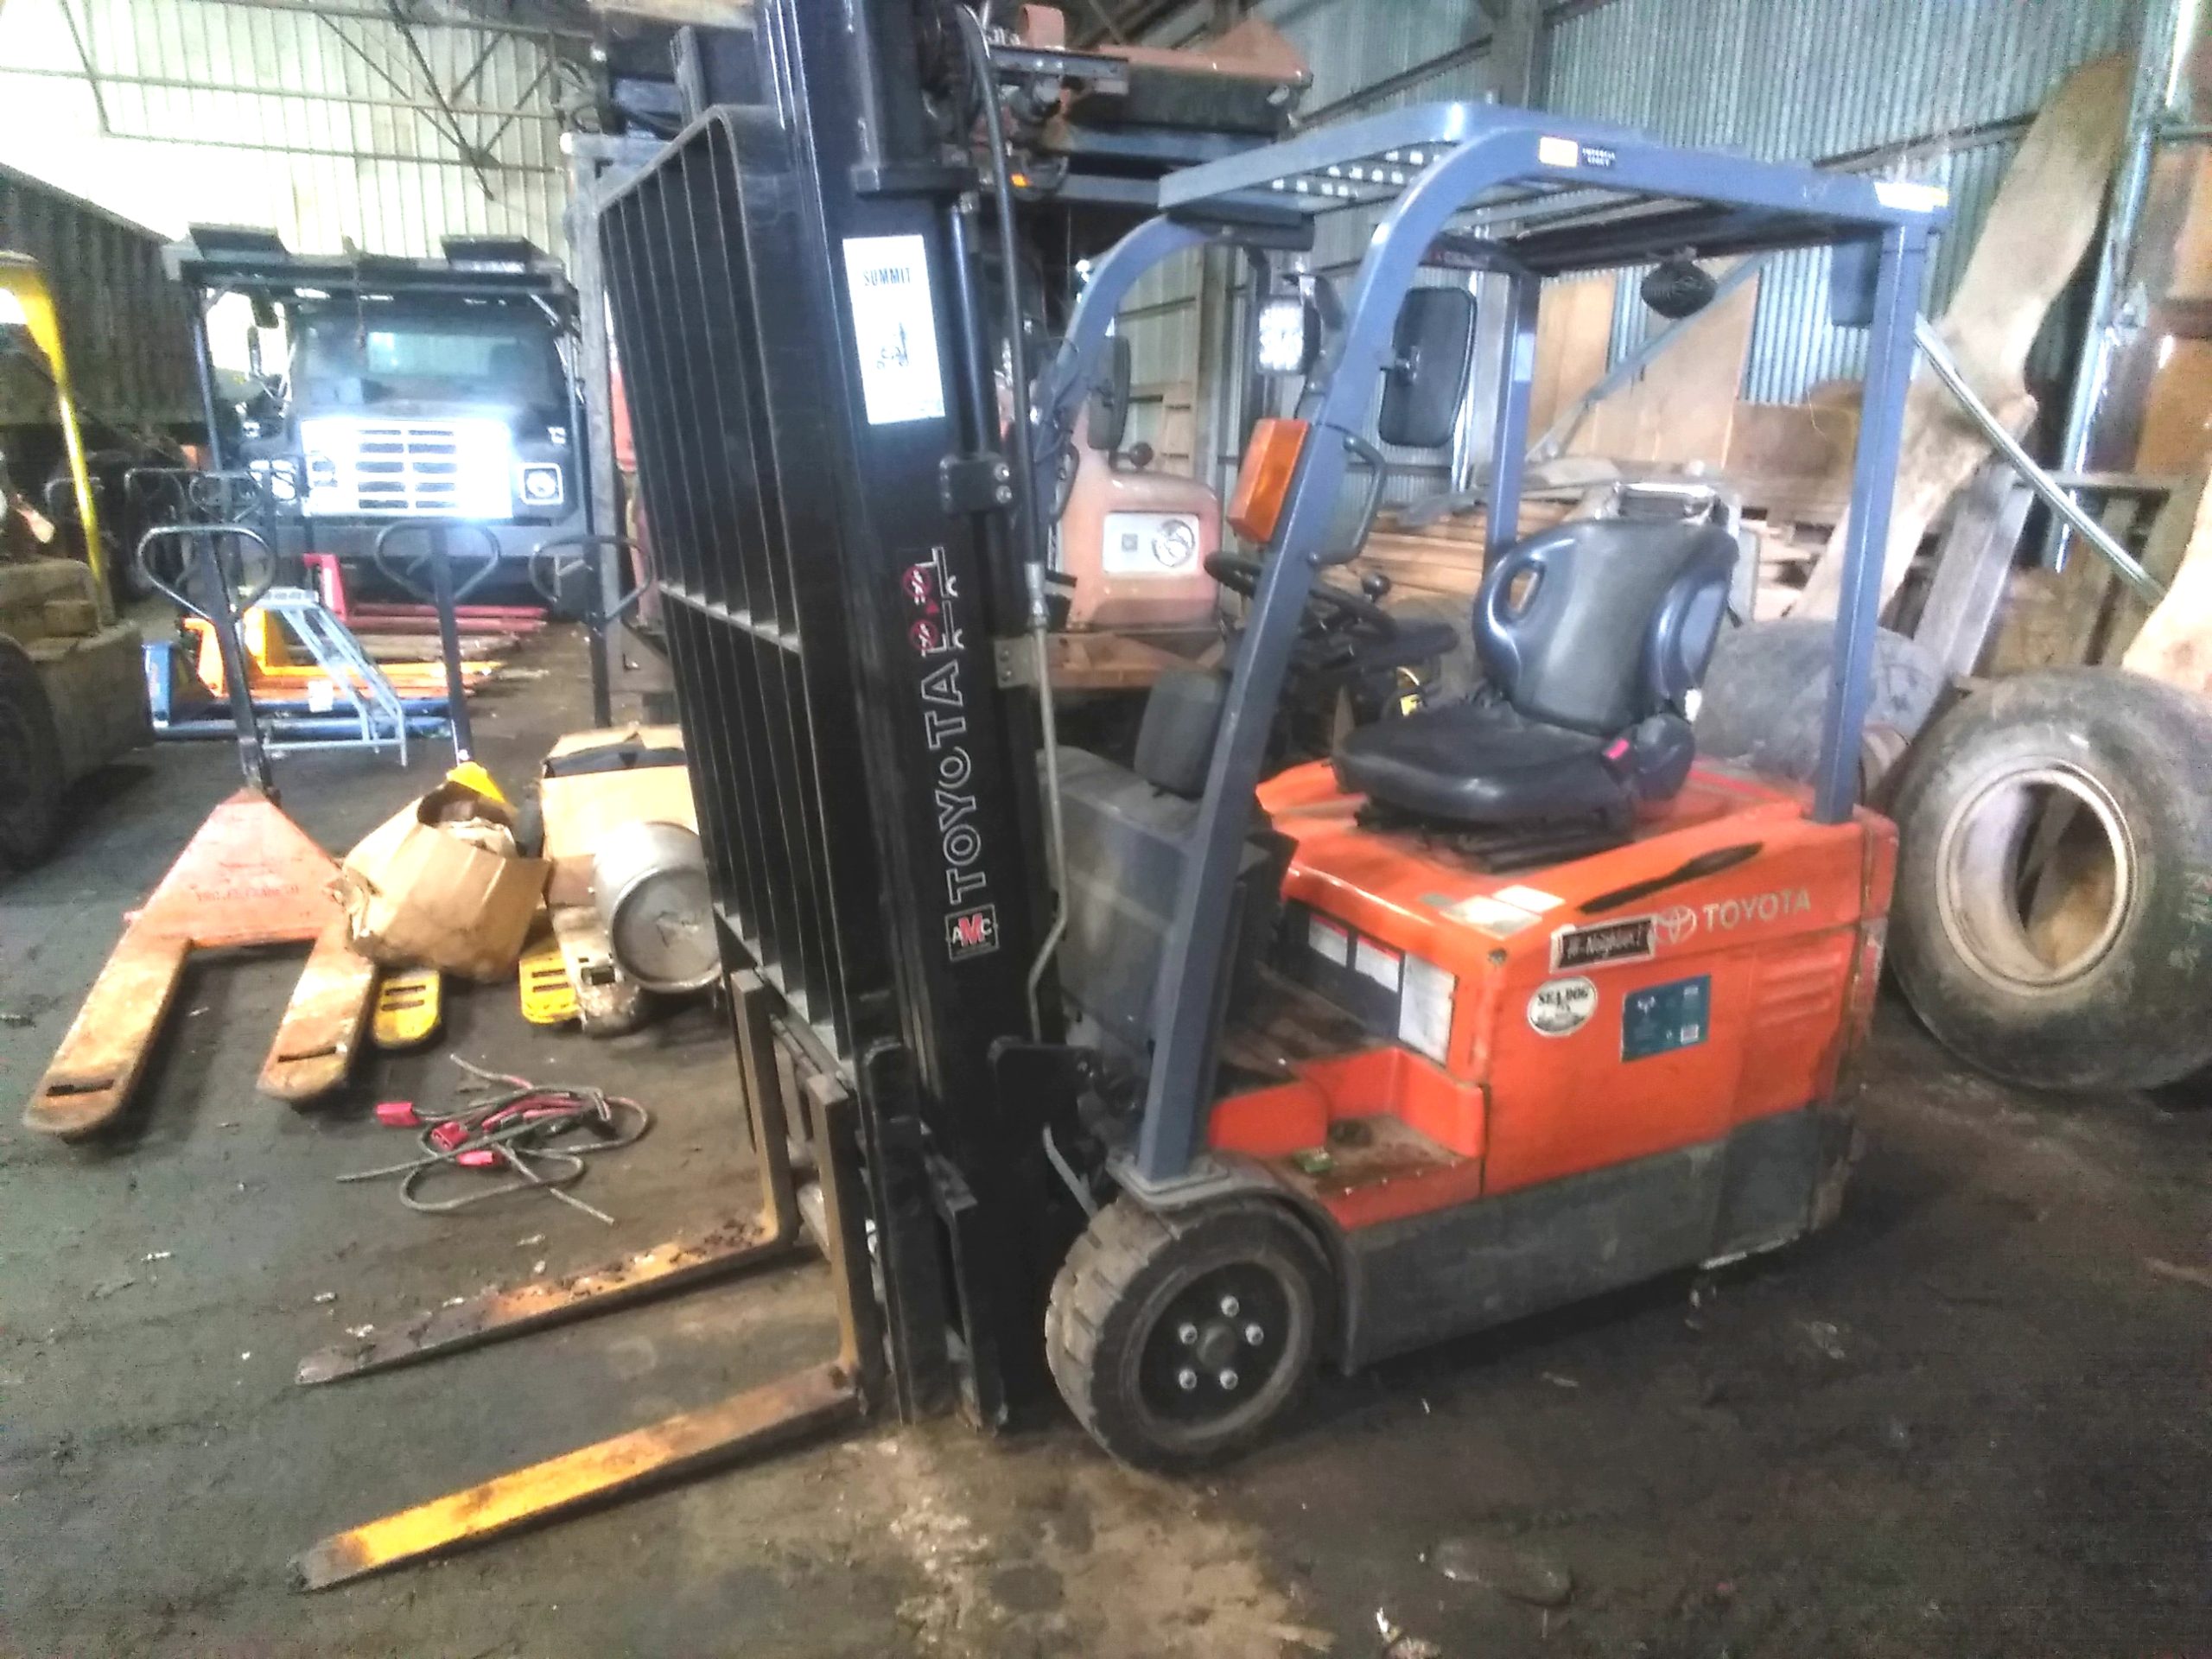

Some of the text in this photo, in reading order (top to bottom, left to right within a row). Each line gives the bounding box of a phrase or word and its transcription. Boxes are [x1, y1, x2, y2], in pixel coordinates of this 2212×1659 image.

[863, 267, 911, 286] SUMMIT
[920, 658, 987, 905] TOYOTA
[952, 912, 993, 947] AMC
[1702, 887, 1811, 932] TOYOTA
